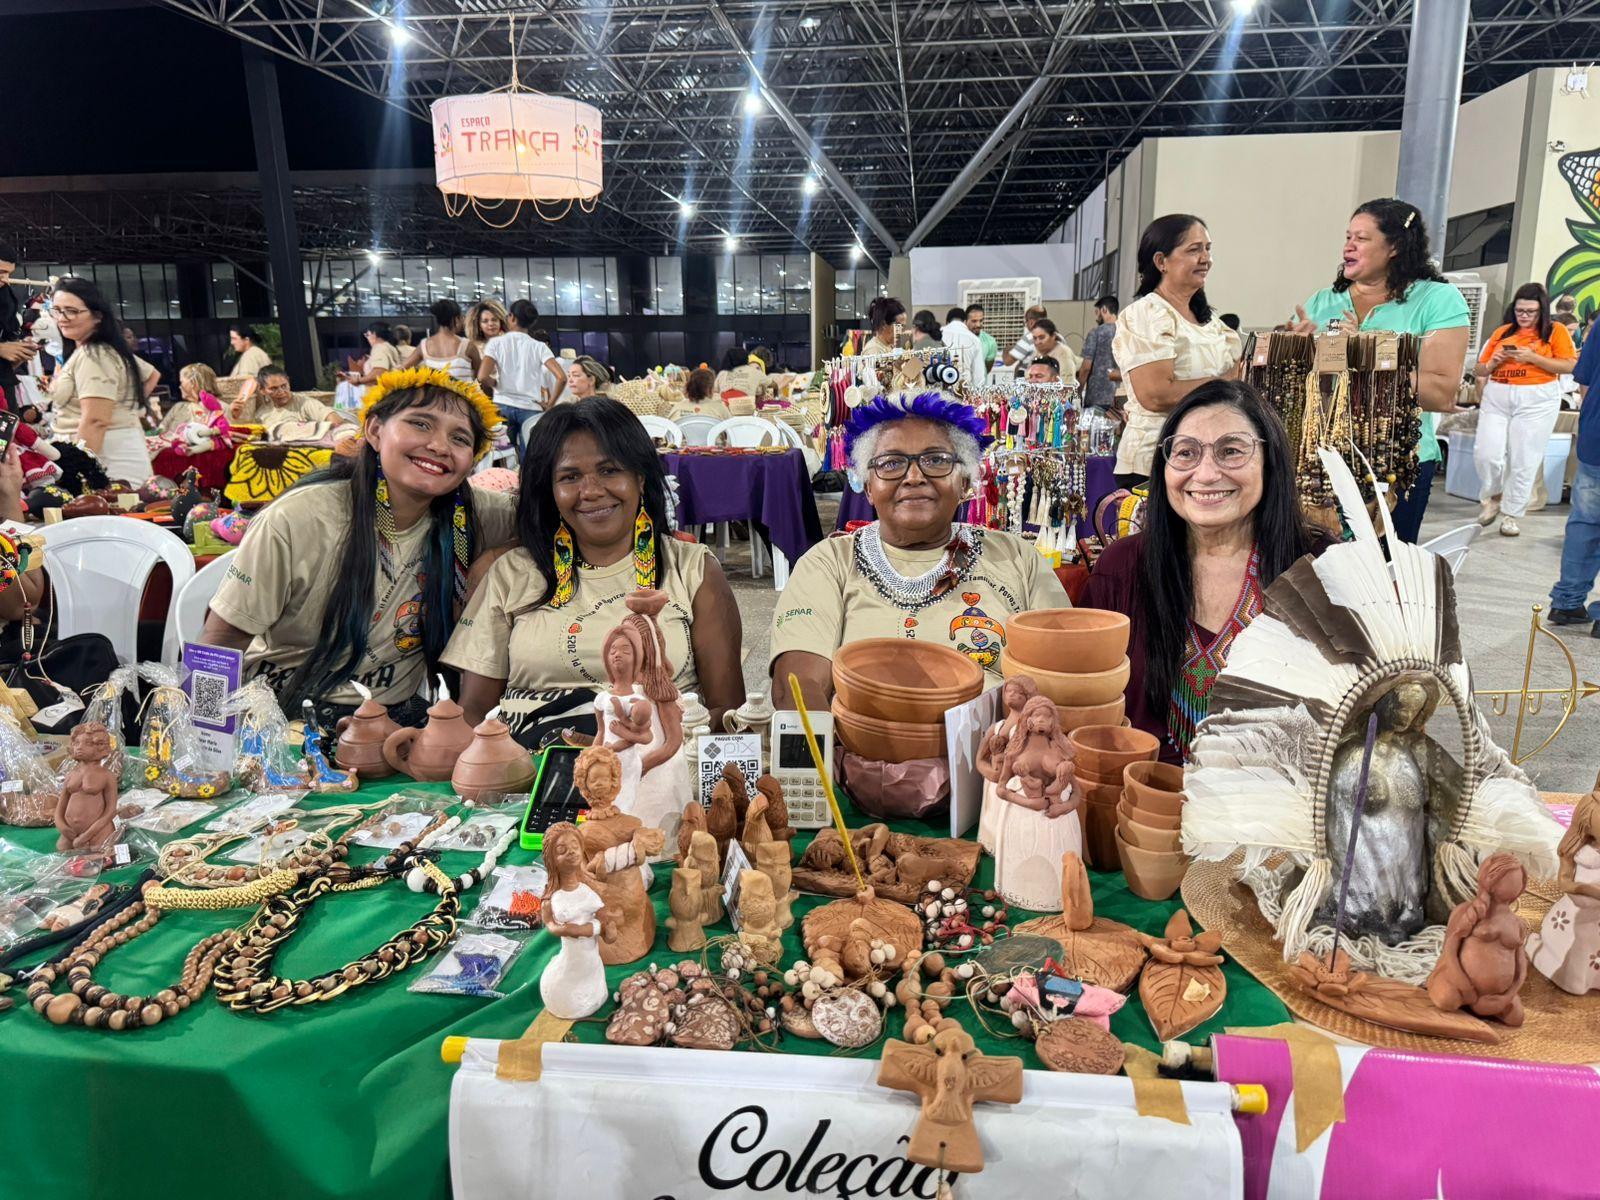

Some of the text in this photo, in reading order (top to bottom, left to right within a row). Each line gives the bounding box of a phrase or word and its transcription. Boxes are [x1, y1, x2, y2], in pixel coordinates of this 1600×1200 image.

[461, 128, 559, 156] TRANÇA
[229, 564, 252, 586] SENAR
[998, 585, 1016, 607] Povos
[785, 608, 812, 617] SENAR
[567, 635, 577, 654] 2025
[698, 1105, 960, 1200] Coleção
